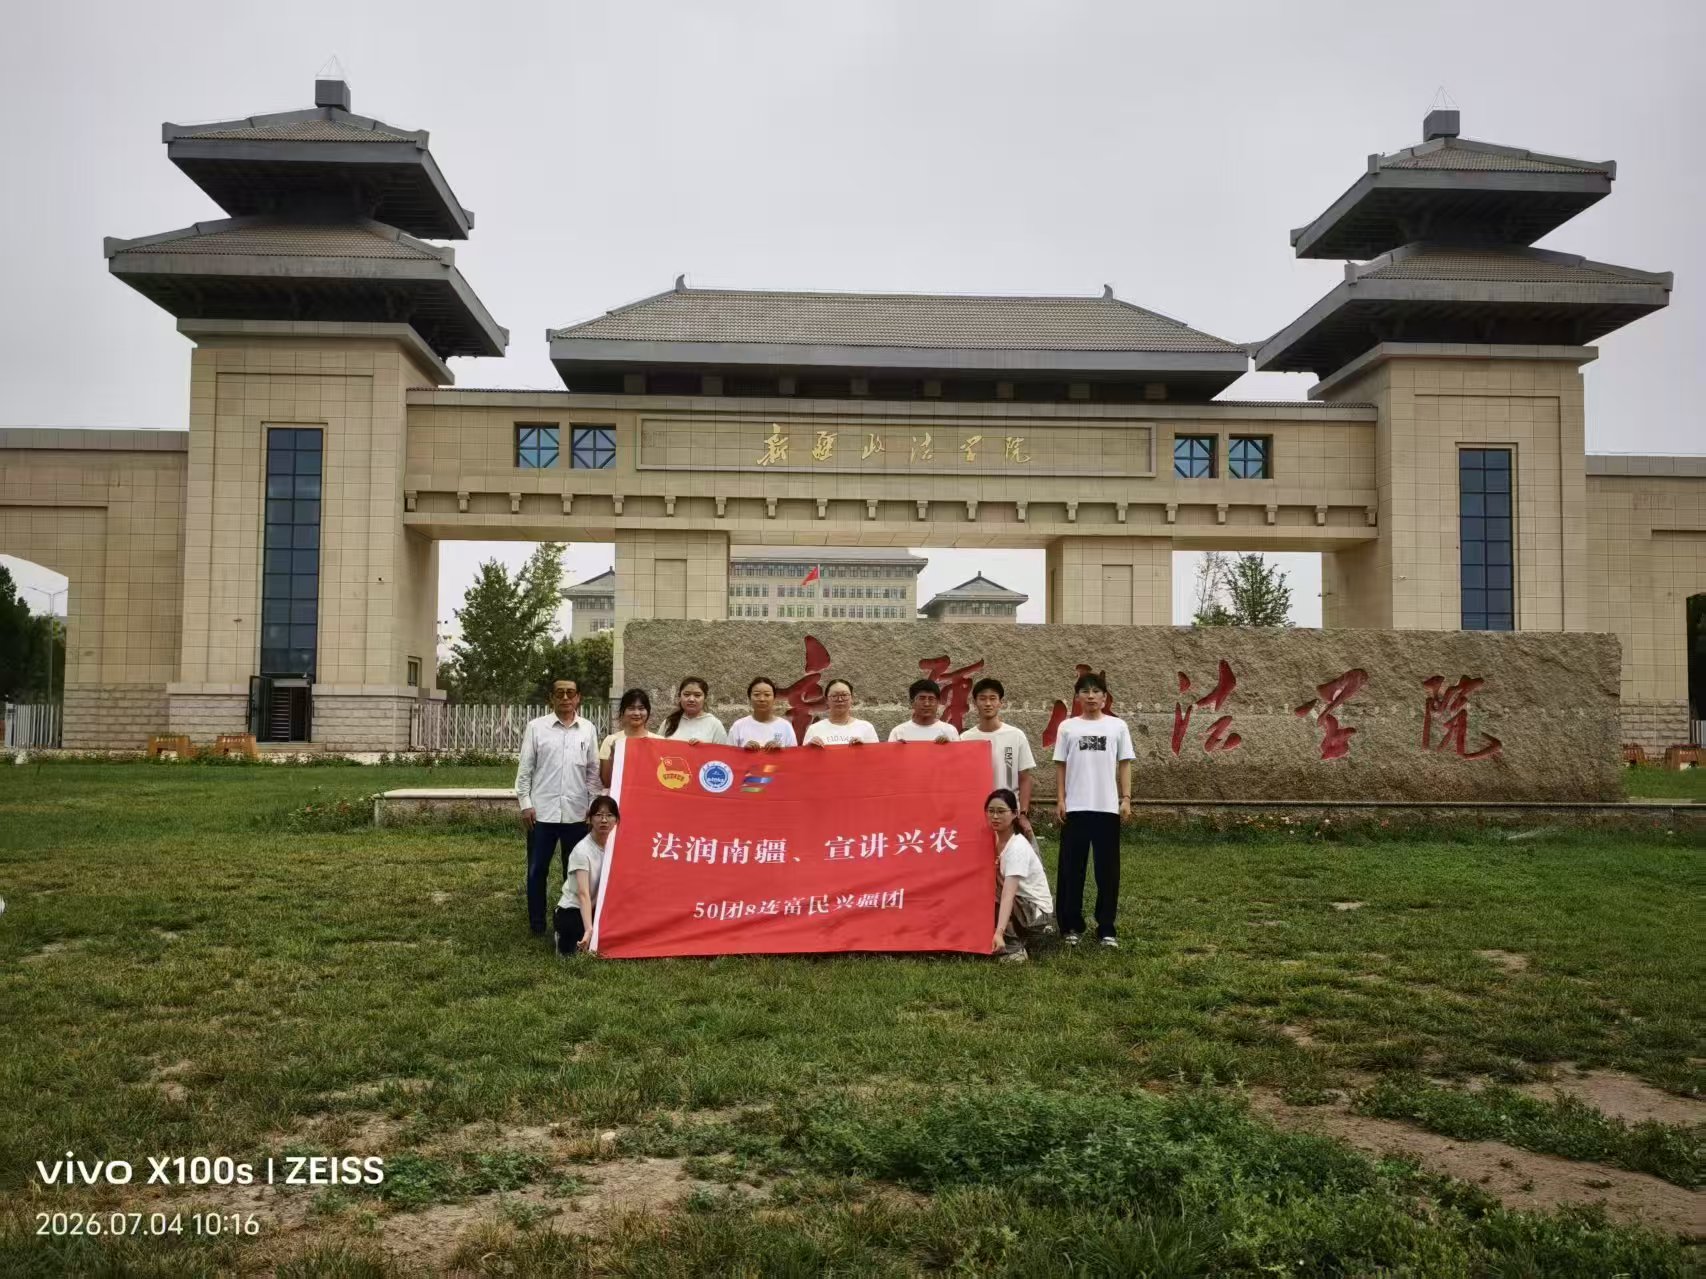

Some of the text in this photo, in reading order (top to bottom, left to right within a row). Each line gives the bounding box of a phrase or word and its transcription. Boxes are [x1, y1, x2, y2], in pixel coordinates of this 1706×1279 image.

[756, 423, 1031, 466] 新疆政法学院
[693, 888, 905, 921] 50团8连富民兴疆团
